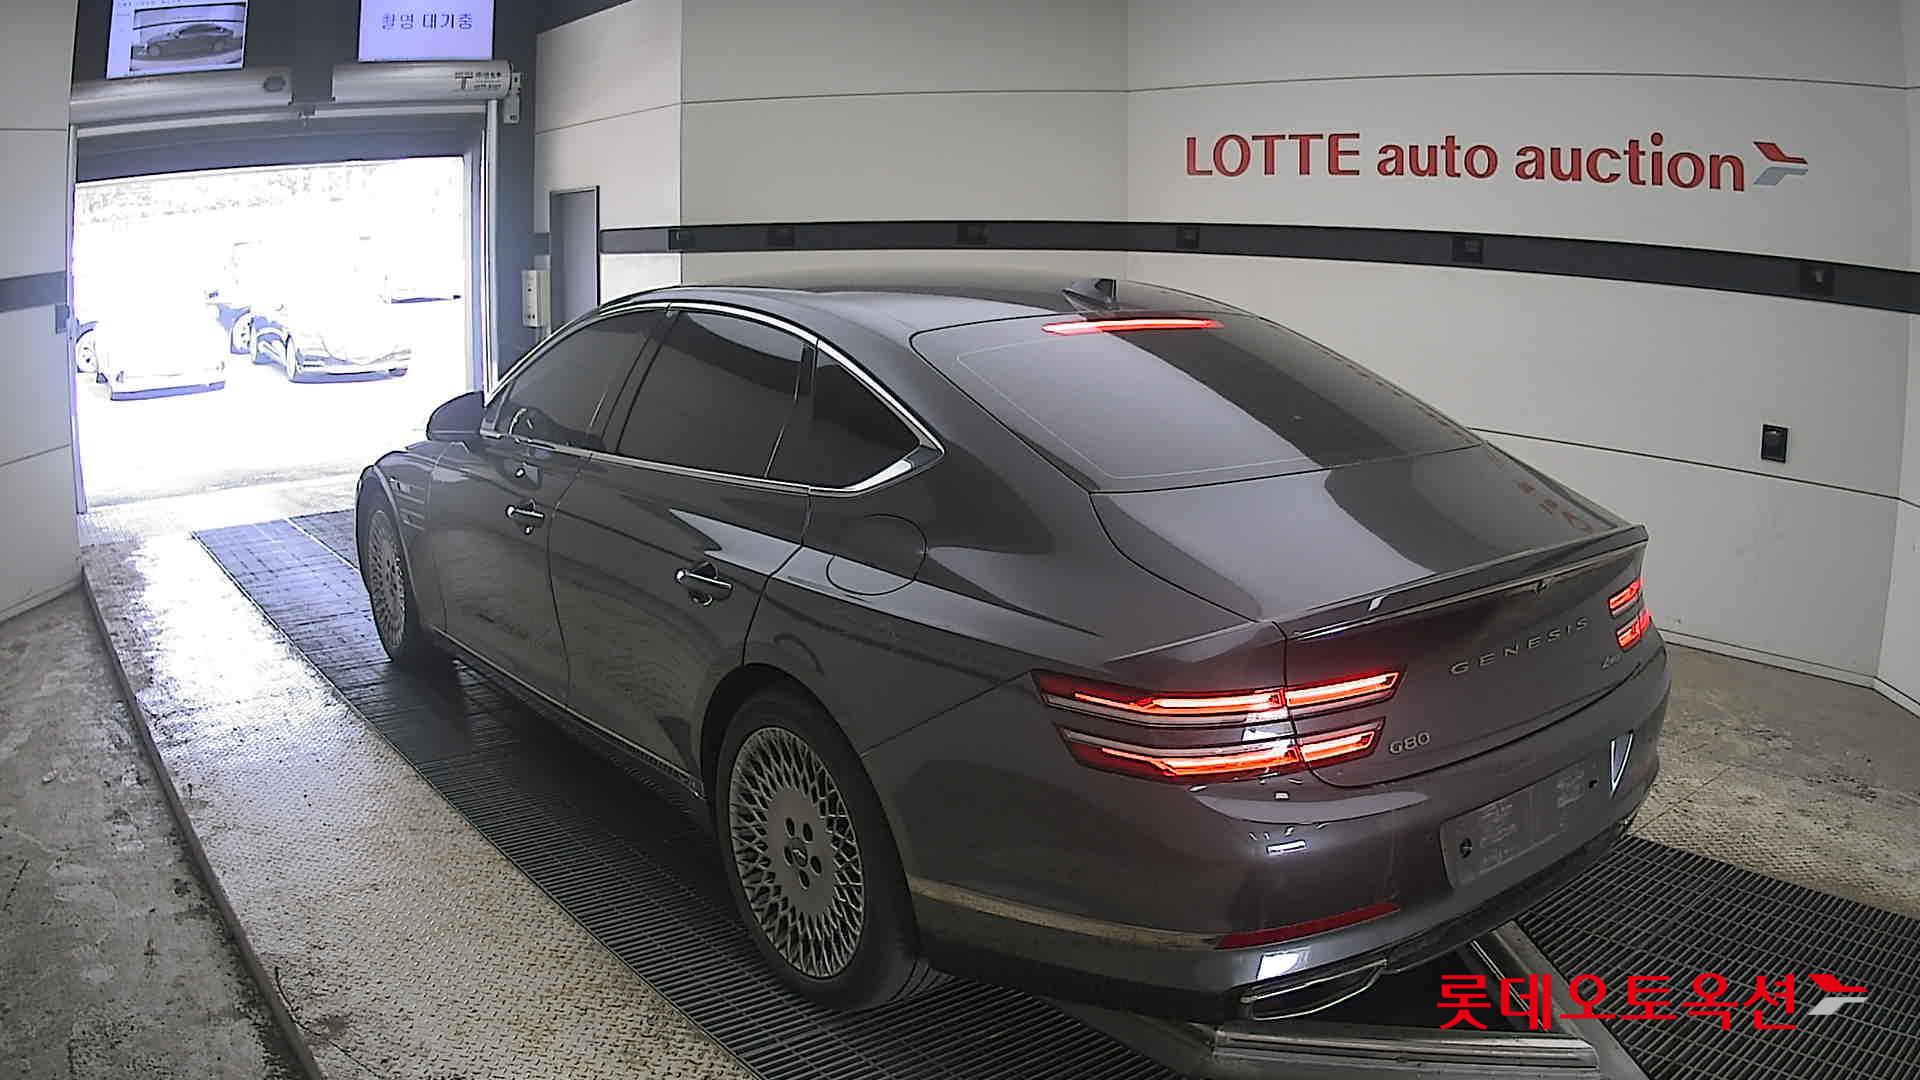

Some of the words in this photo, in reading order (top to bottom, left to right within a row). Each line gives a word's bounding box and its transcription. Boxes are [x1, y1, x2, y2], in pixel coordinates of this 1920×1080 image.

[1186, 132, 1361, 177] LOTTE
[1377, 135, 1498, 178] auto
[1514, 132, 1746, 192] auction
[1450, 616, 1589, 674] GENESIS
[1389, 731, 1431, 754] G80
